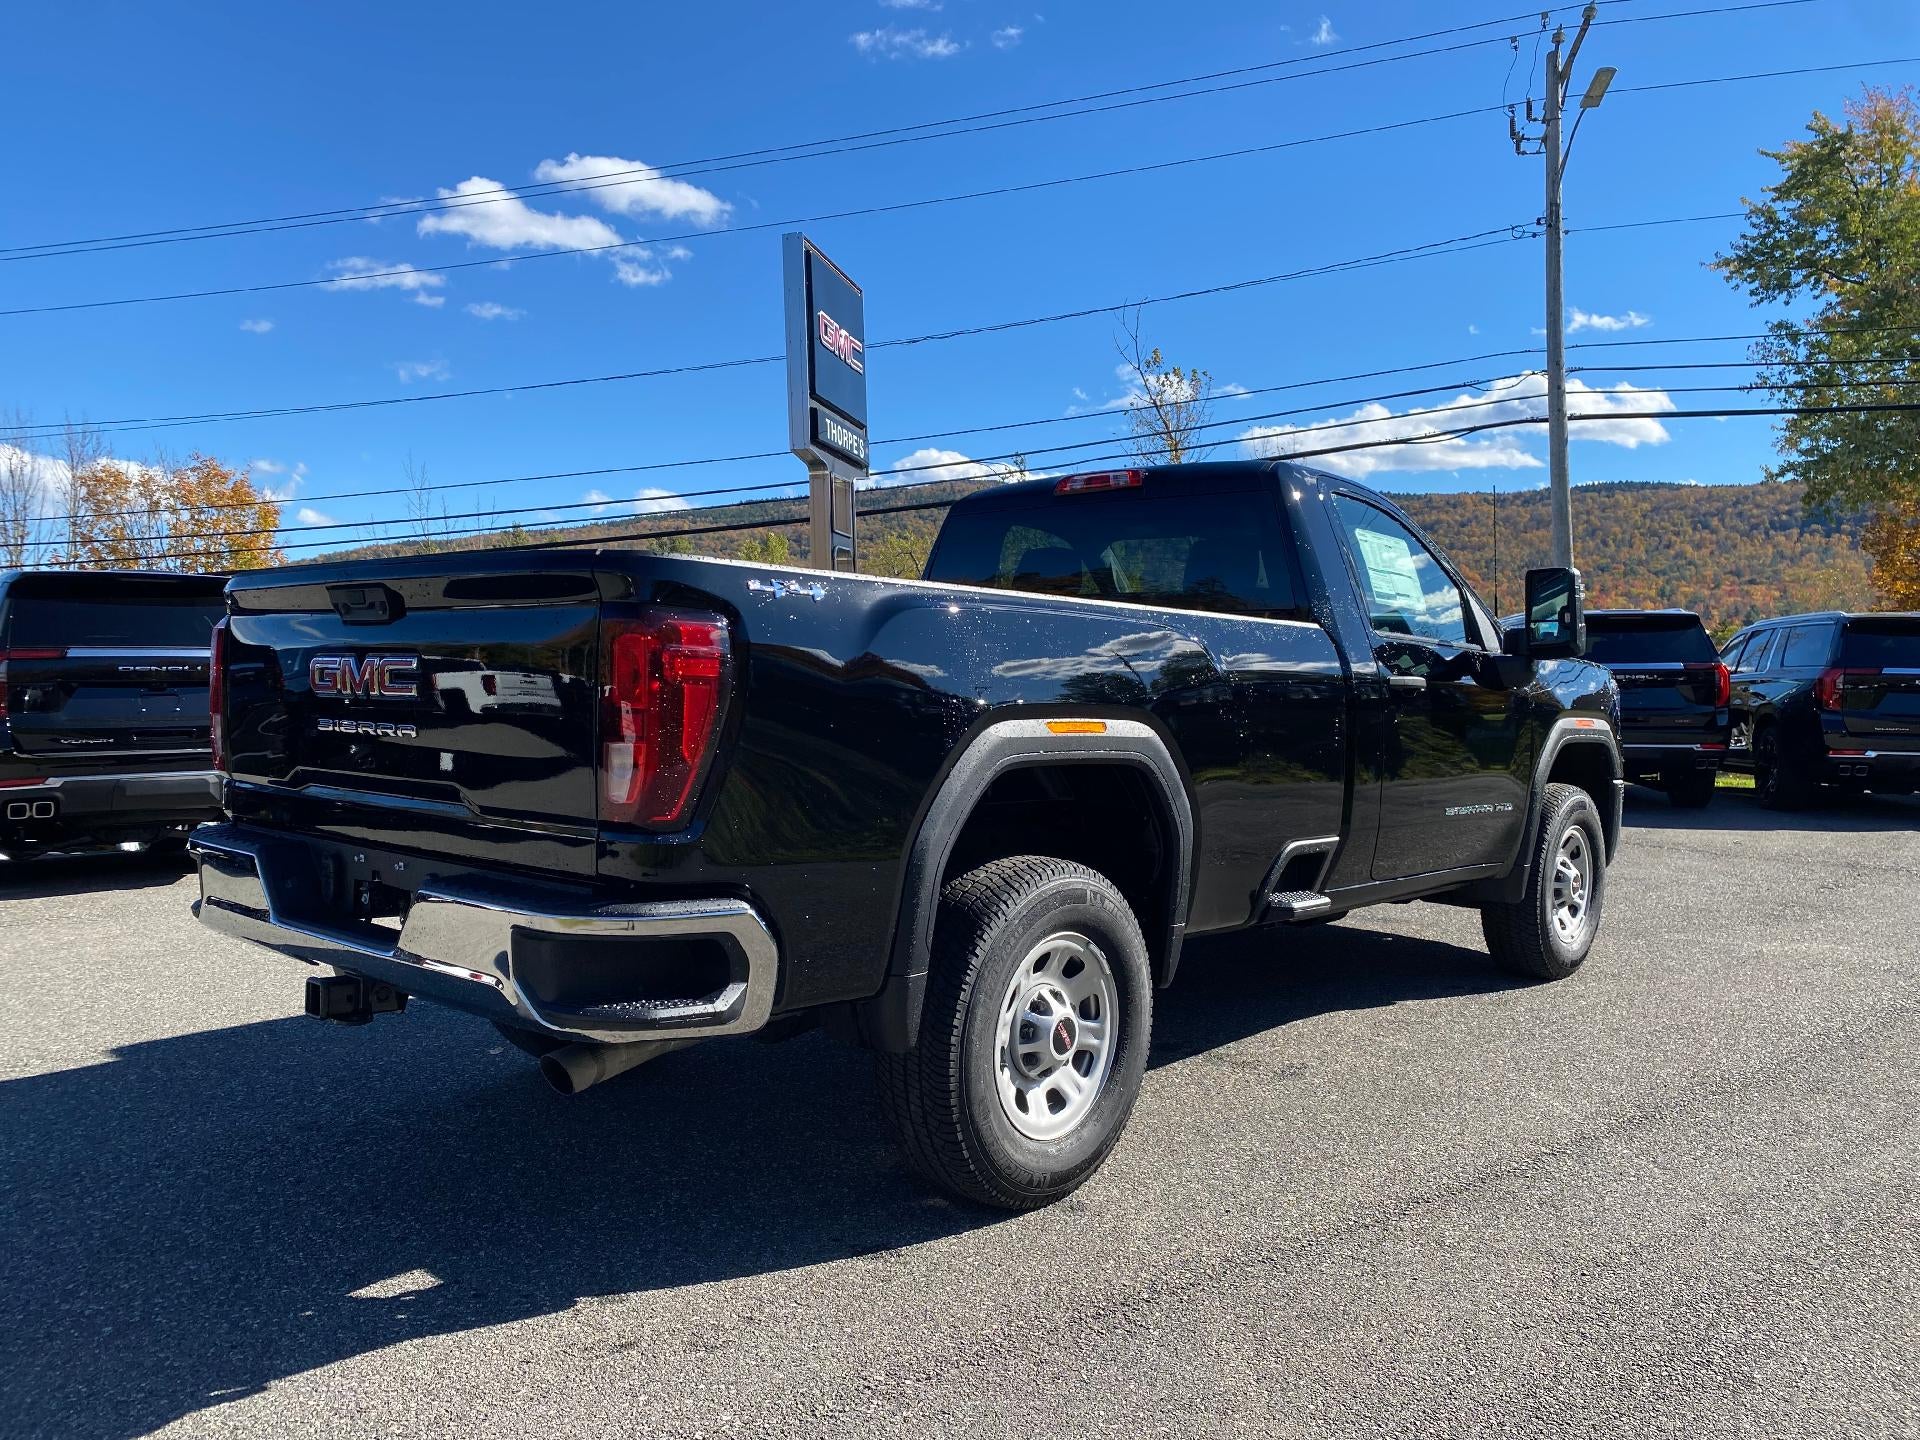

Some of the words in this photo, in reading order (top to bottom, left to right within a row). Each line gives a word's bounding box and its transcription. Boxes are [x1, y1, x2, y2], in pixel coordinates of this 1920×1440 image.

[818, 310, 864, 375] GMC
[826, 418, 865, 459] THORPE'S
[309, 654, 418, 697] GMC
[317, 718, 418, 738] SIERRA
